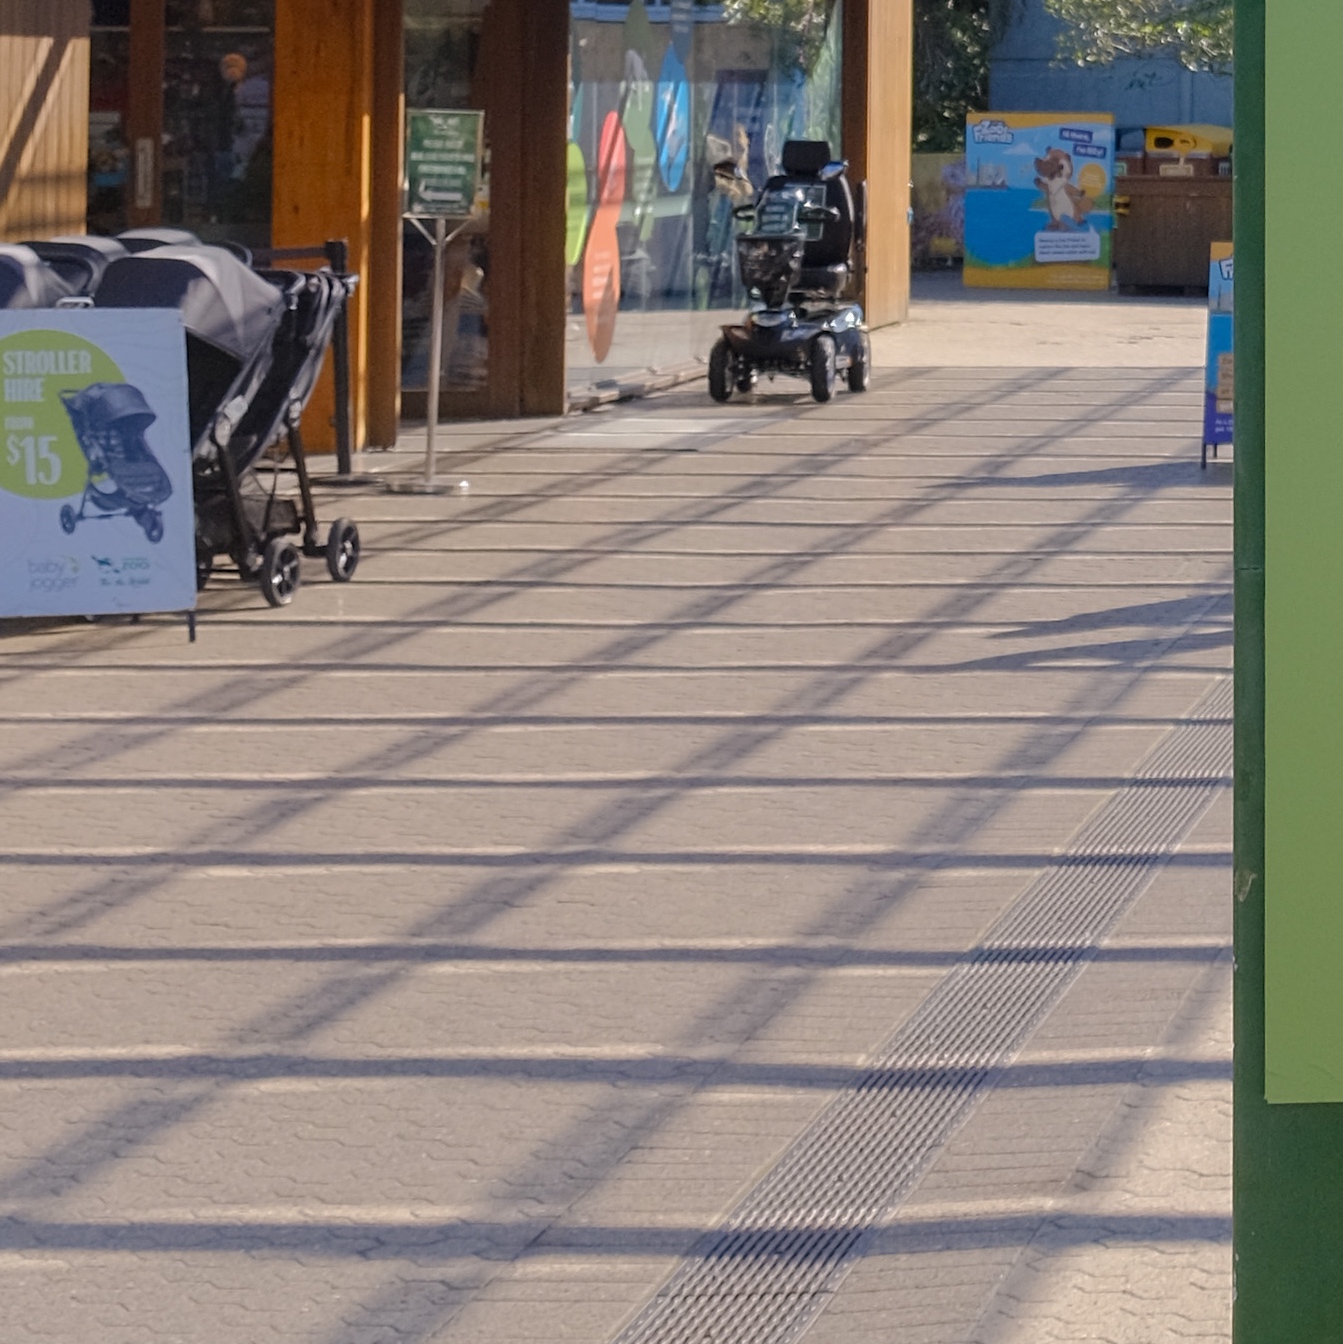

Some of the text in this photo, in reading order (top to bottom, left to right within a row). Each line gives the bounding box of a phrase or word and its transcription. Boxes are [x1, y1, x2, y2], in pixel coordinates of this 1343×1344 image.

[2, 349, 92, 376] STROLLER
[4, 377, 45, 402] HIRE
[6, 433, 62, 485] $15
